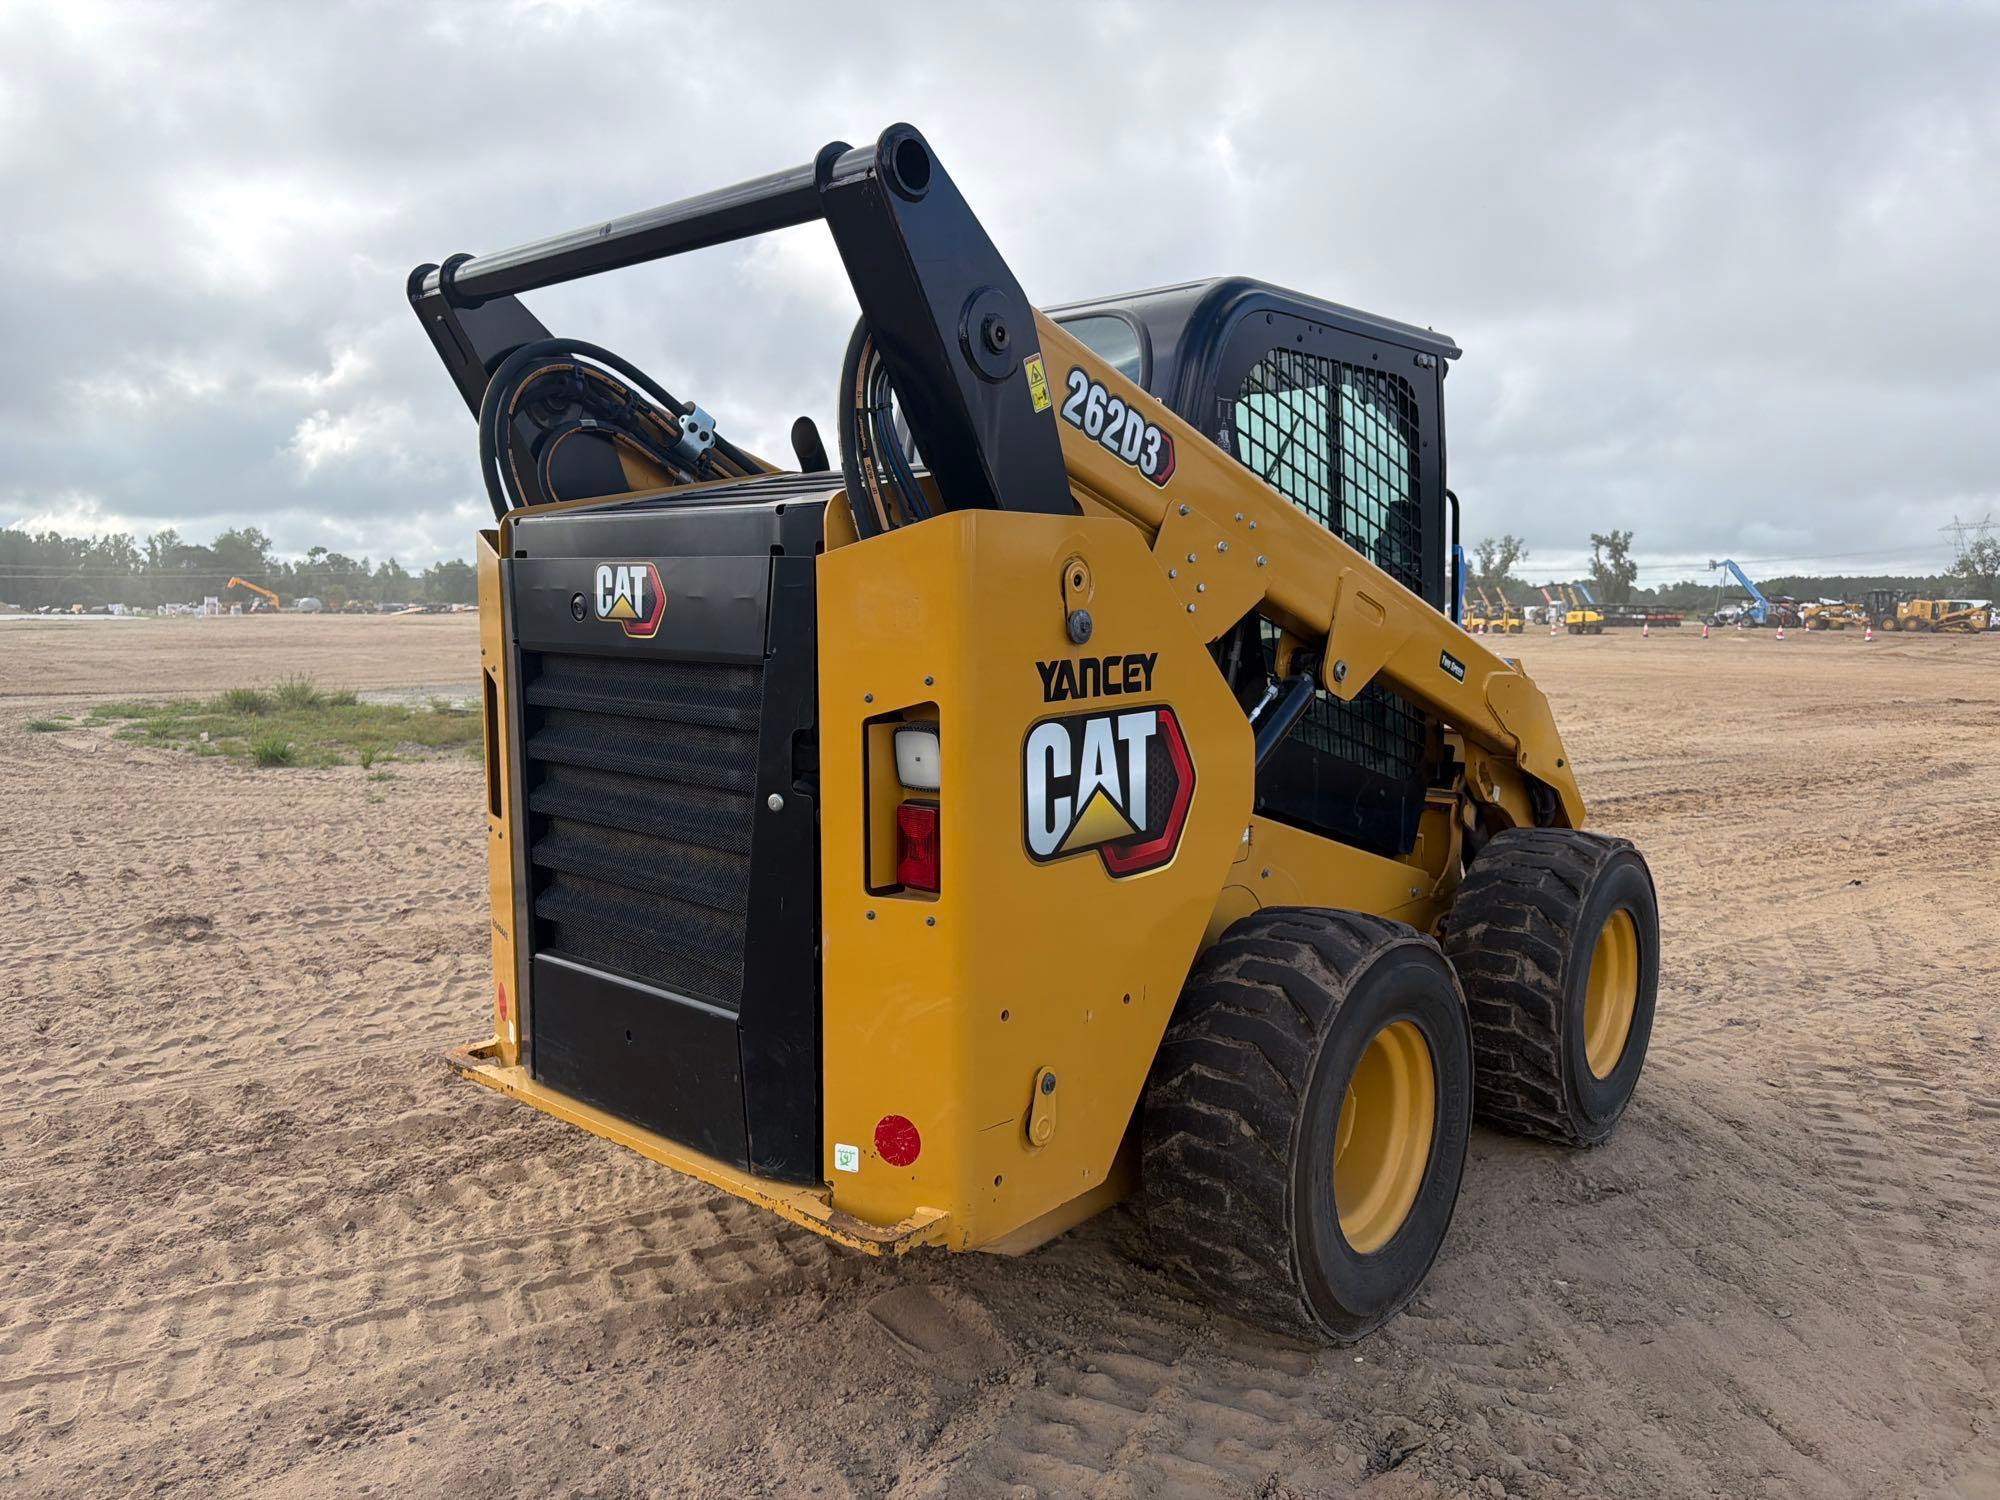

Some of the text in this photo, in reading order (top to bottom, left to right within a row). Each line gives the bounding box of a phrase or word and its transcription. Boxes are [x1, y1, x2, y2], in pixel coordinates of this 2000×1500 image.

[1062, 370, 1162, 475] 262D3
[596, 565, 647, 619] CAT
[1035, 652, 1159, 703] YANCEY
[1026, 710, 1157, 857] CAT
